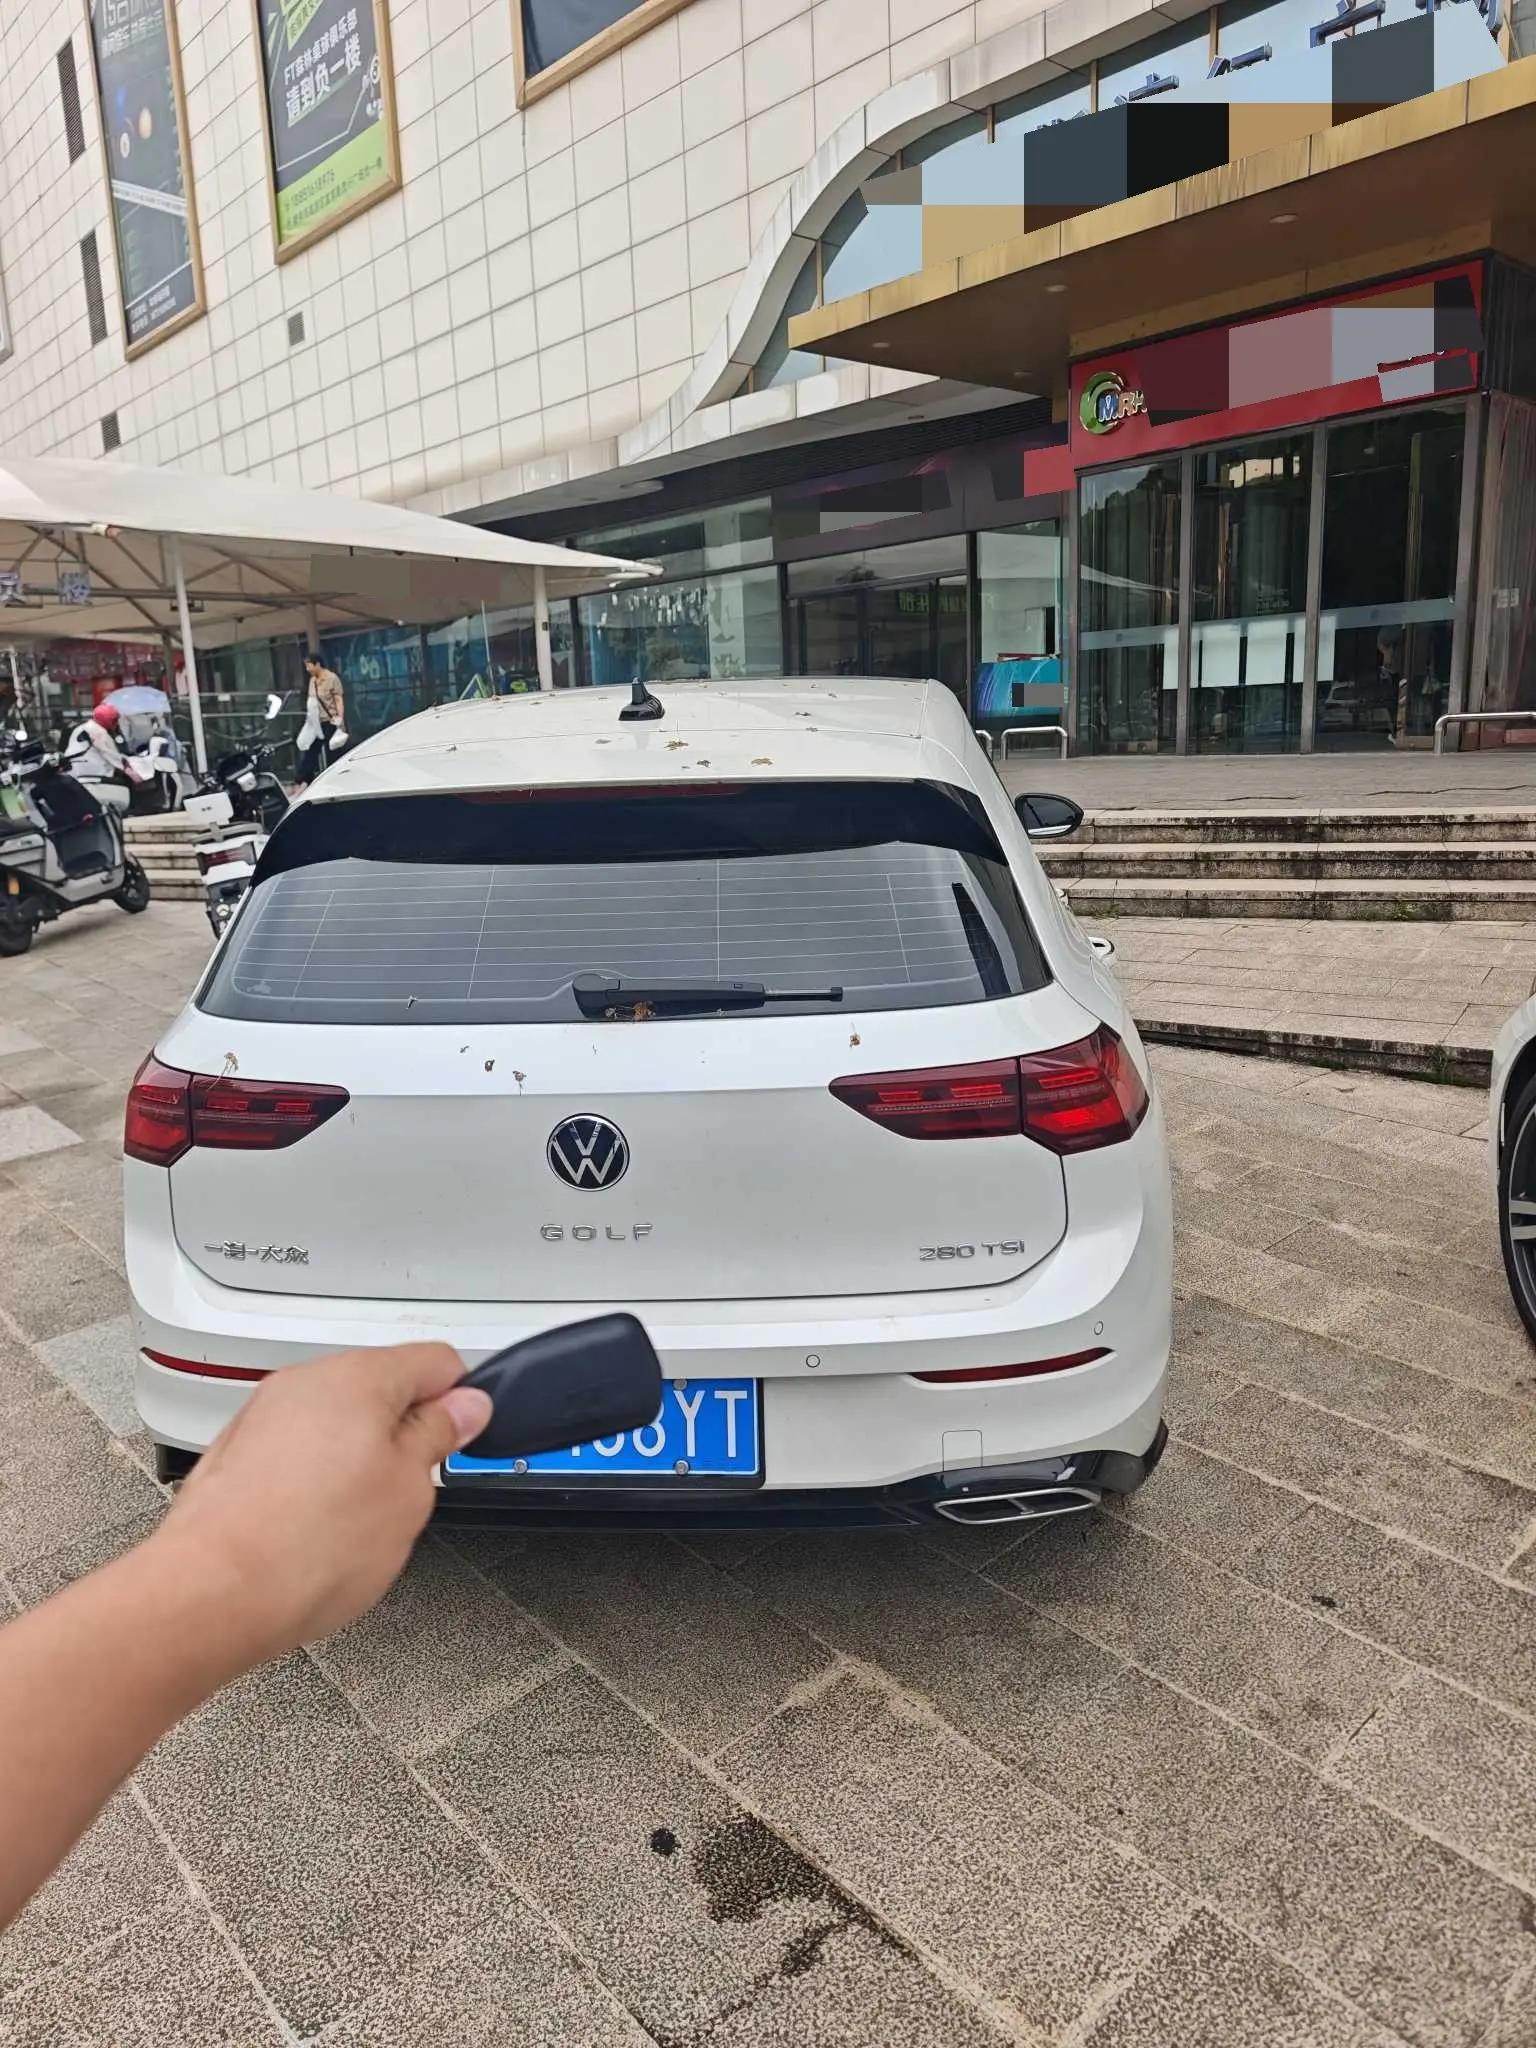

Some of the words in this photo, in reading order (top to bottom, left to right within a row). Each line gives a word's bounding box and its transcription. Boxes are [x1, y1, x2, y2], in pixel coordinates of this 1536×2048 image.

[286, 33, 361, 122] 请到负一楼
[548, 1117, 625, 1187] VW
[540, 1223, 653, 1241] GOLF
[919, 1244, 976, 1262] 280
[981, 1239, 1025, 1257] TSI
